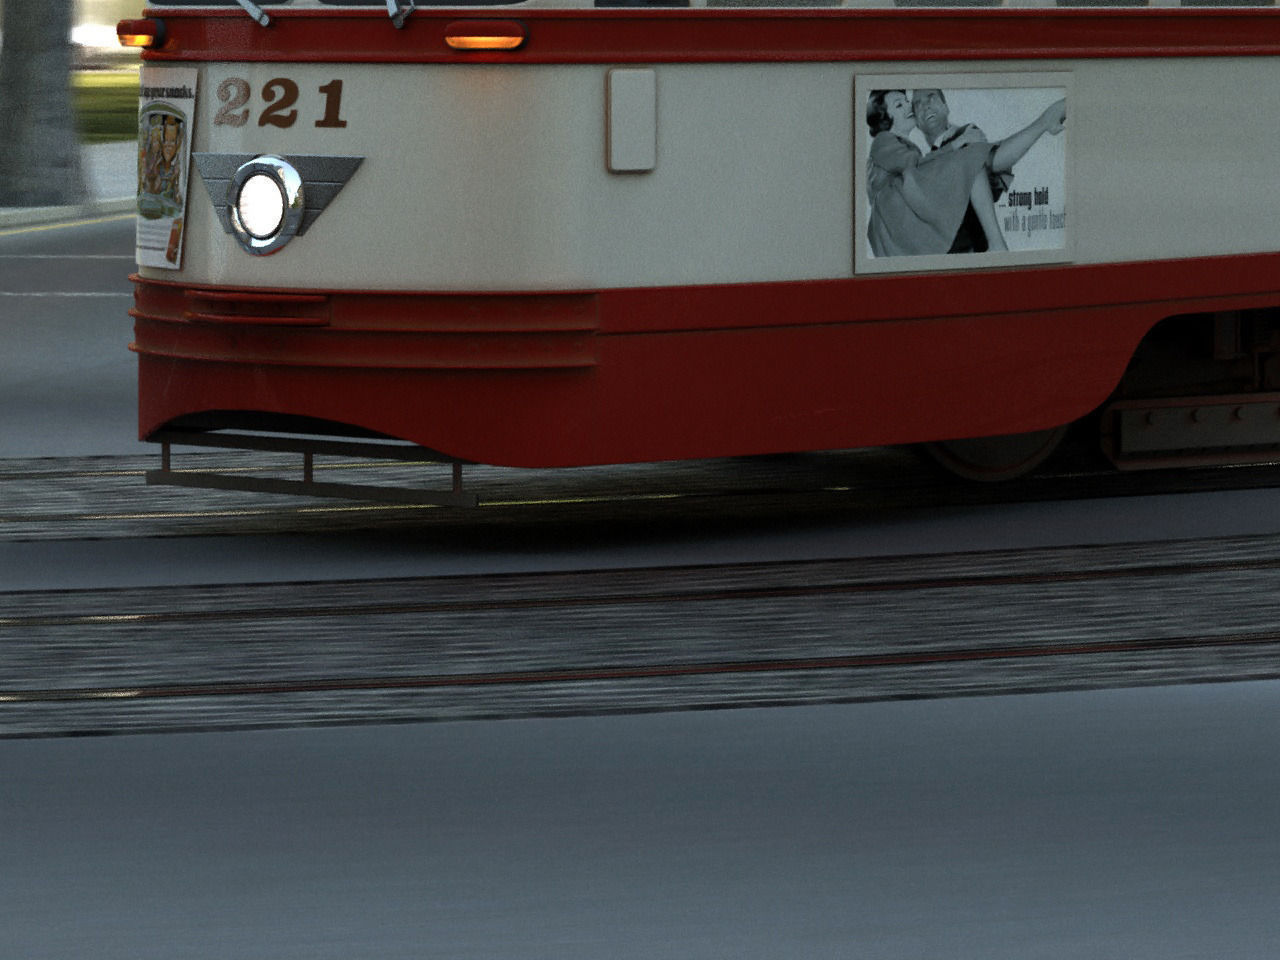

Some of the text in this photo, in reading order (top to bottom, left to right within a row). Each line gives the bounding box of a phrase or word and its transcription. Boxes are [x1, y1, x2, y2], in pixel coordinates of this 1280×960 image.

[214, 77, 347, 128] 221
[1008, 190, 1032, 210] strong
[1034, 187, 1049, 206] hold
